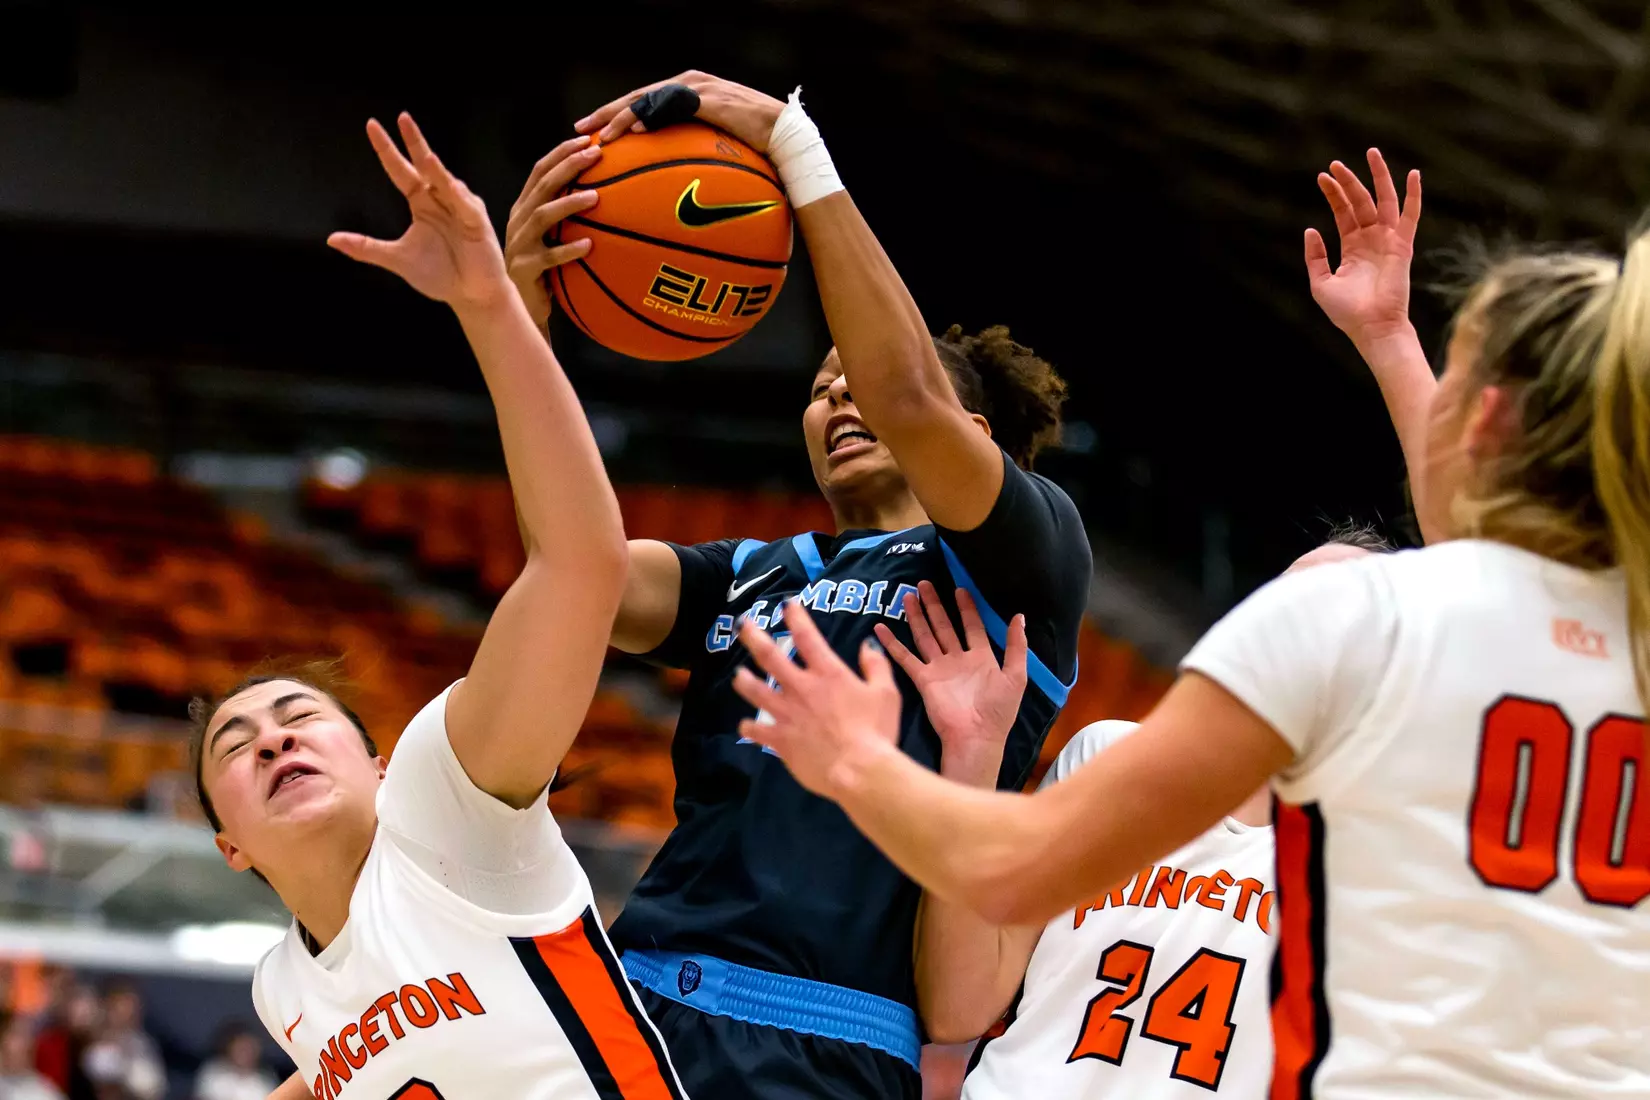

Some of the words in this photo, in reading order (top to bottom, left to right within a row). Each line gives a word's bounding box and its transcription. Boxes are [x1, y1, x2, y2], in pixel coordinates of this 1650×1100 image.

[648, 262, 772, 317] ELITE
[1467, 692, 1650, 909] 00
[313, 972, 486, 1100] RINCETON
[1065, 939, 1247, 1093] 24
